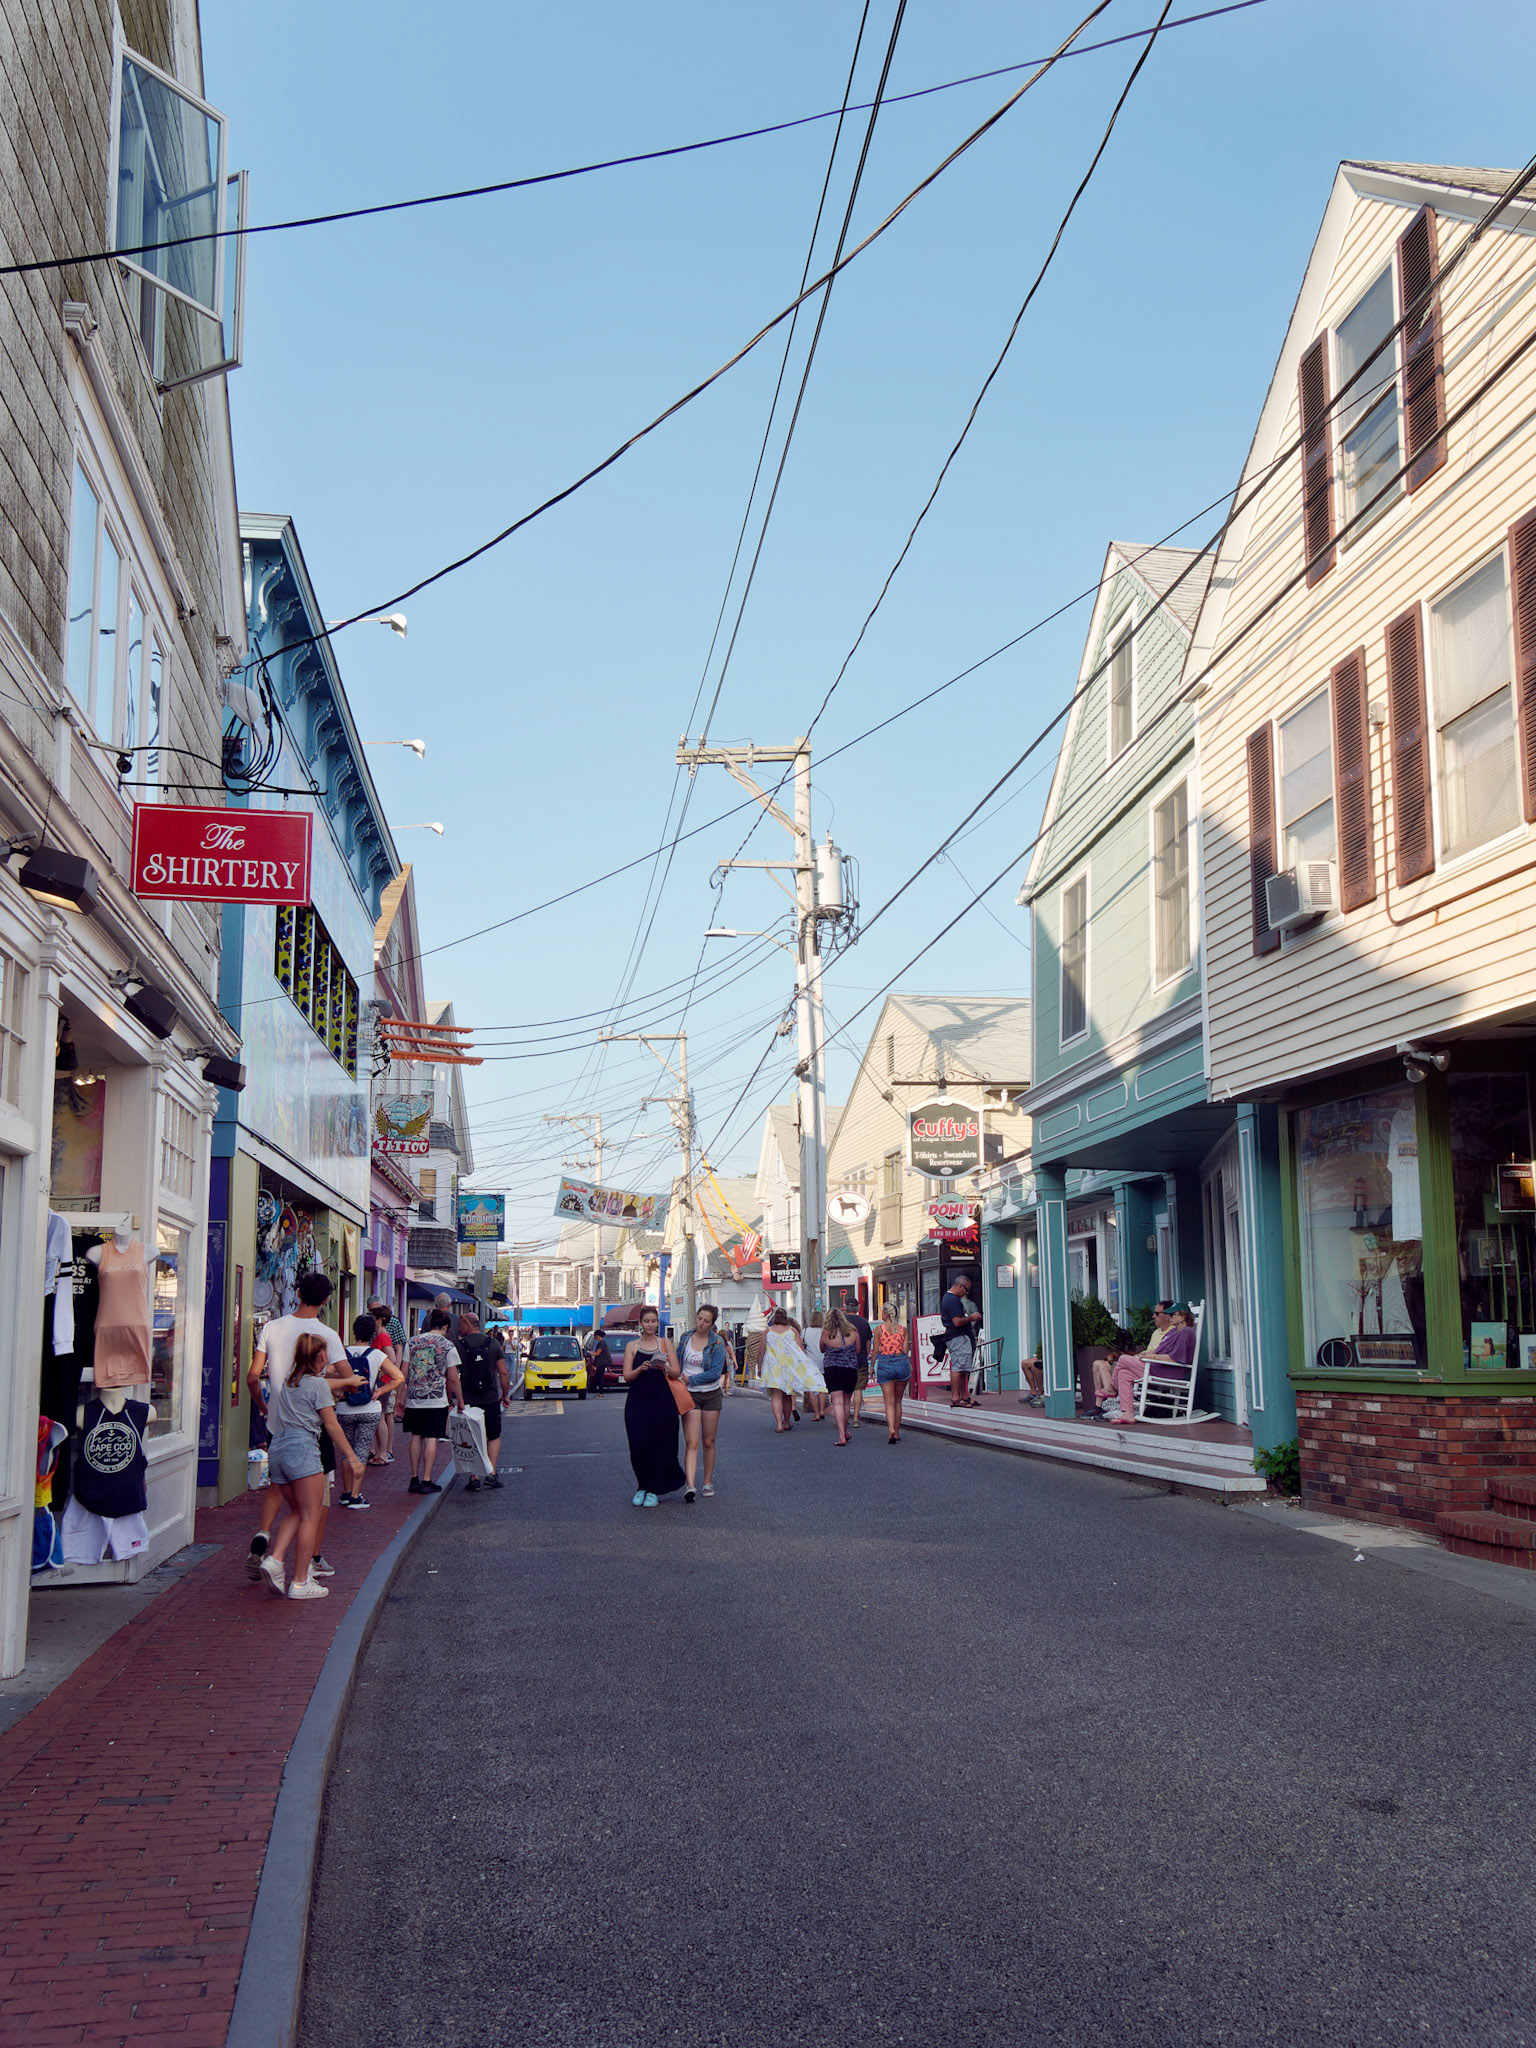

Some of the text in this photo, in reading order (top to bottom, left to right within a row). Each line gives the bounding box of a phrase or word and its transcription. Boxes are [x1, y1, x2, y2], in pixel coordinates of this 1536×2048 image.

[200, 823, 246, 850] The
[142, 853, 300, 890] SHIRTERY
[913, 1117, 978, 1141] Cuffy's
[377, 1140, 428, 1153] TATTOO
[943, 1150, 978, 1159] Sweatshirts
[929, 1158, 963, 1166] Resortwear
[460, 1213, 504, 1224] COCONUTS
[771, 1269, 801, 1277] TWISTE
[777, 1275, 800, 1283] PIZZA
[90, 1443, 132, 1452] CAPE COD
